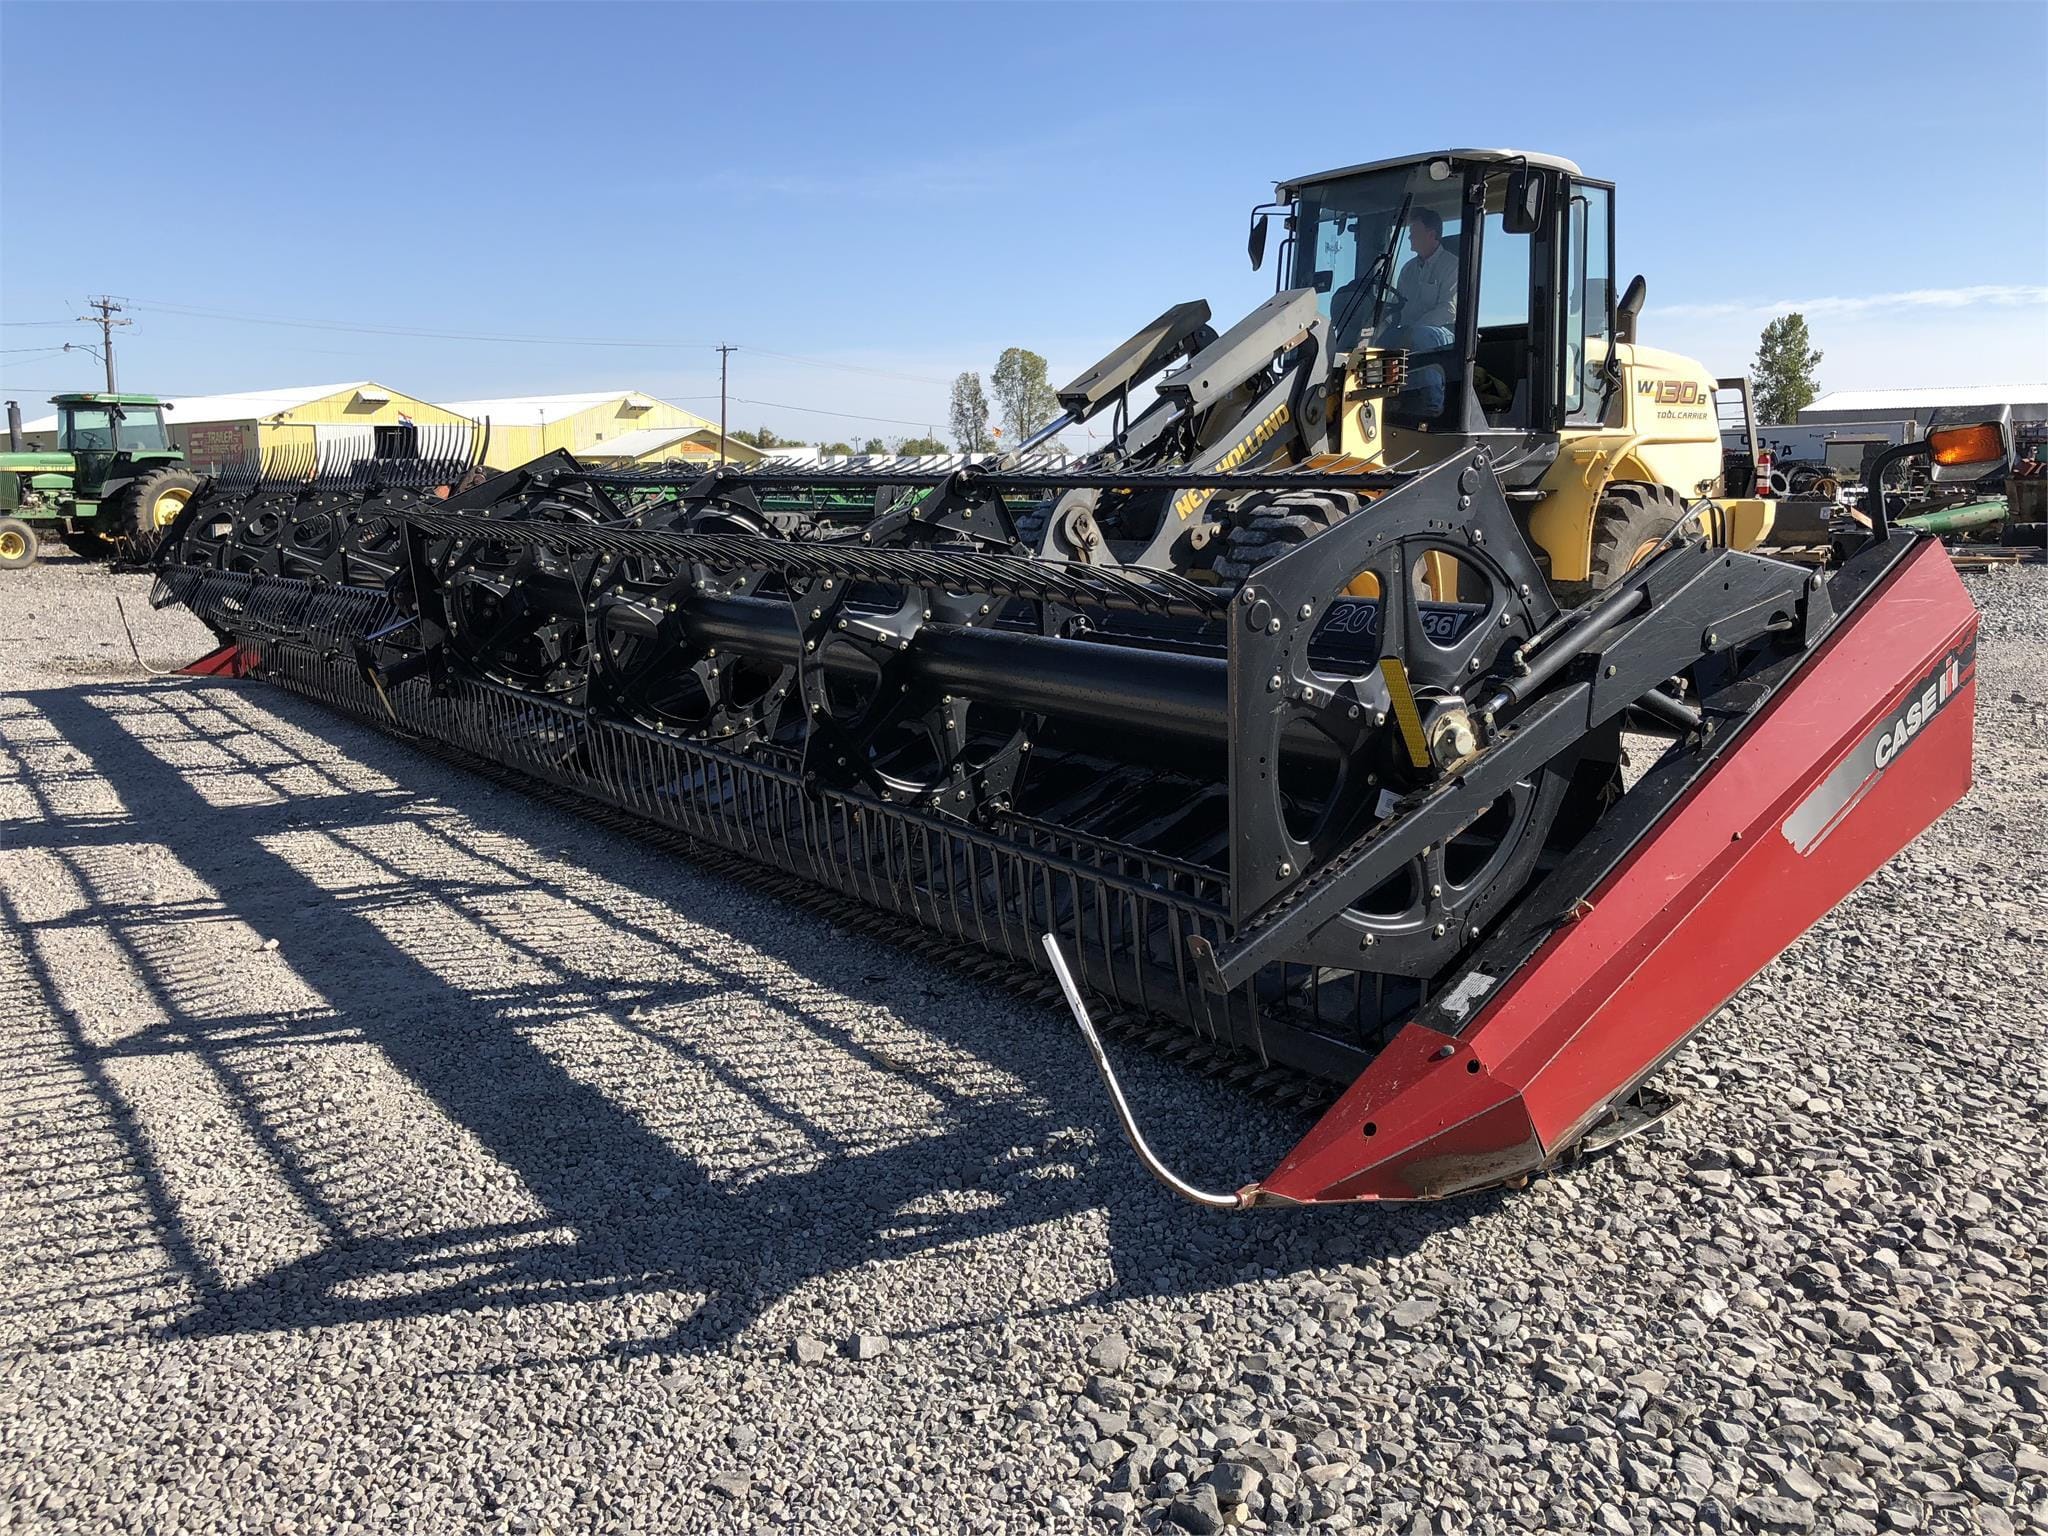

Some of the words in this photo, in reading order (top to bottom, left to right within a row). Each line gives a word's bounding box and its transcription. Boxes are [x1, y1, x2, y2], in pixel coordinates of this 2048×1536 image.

[1657, 411, 1677, 419] TOOL
[1677, 411, 1708, 420] CARRIER
[1424, 614, 1454, 635] 36
[1875, 683, 1937, 770] CASE
